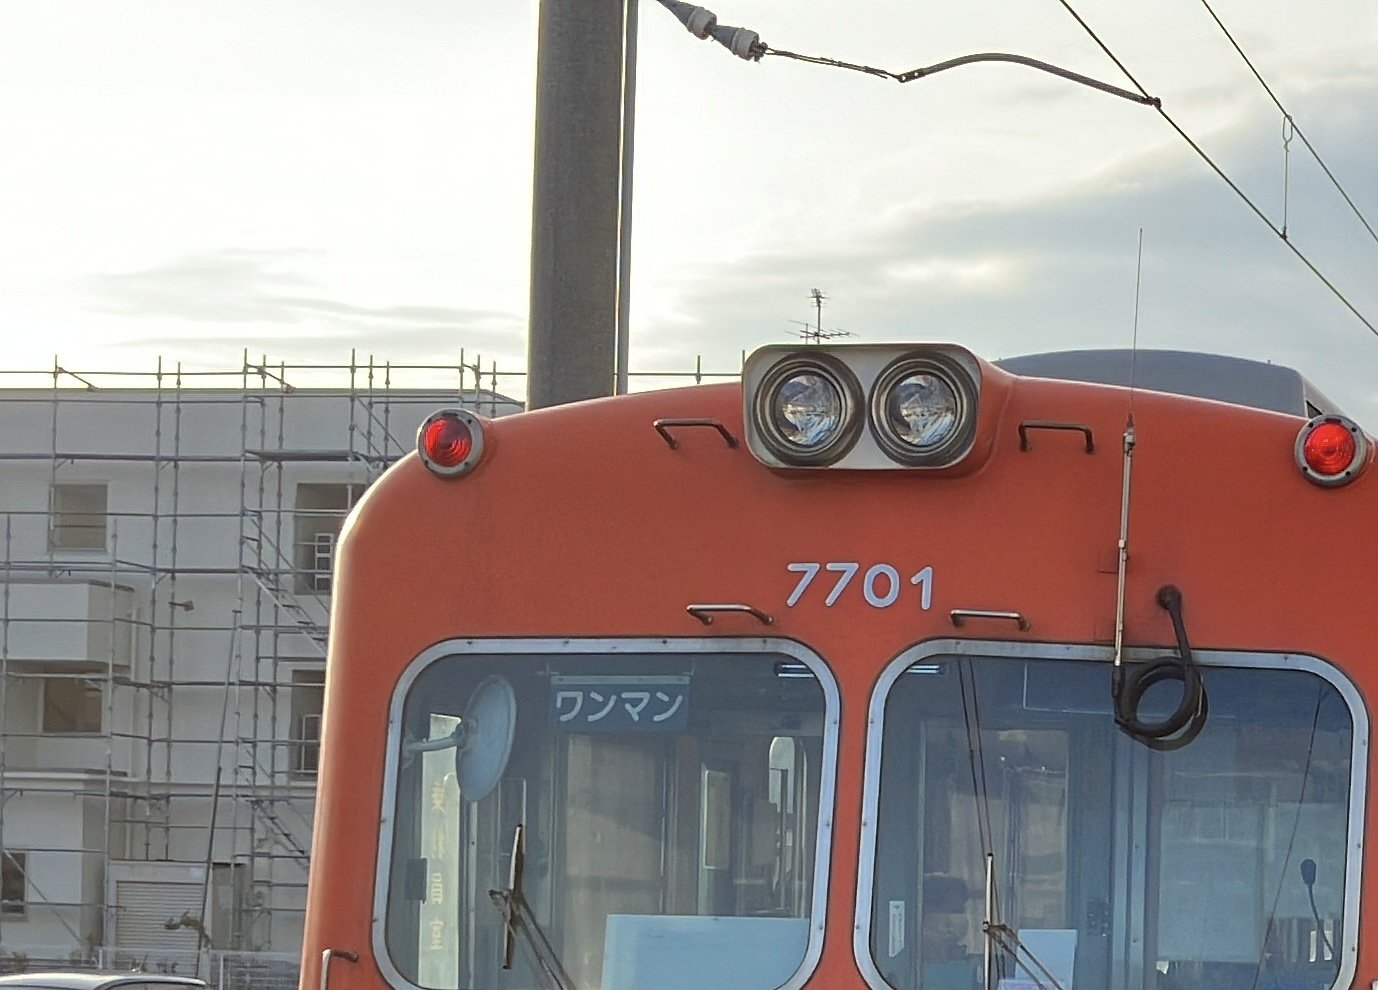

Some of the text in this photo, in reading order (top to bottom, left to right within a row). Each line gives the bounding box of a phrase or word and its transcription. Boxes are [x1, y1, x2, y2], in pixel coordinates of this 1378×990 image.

[786, 562, 934, 611] 7701
[555, 690, 684, 723] ワンマン
